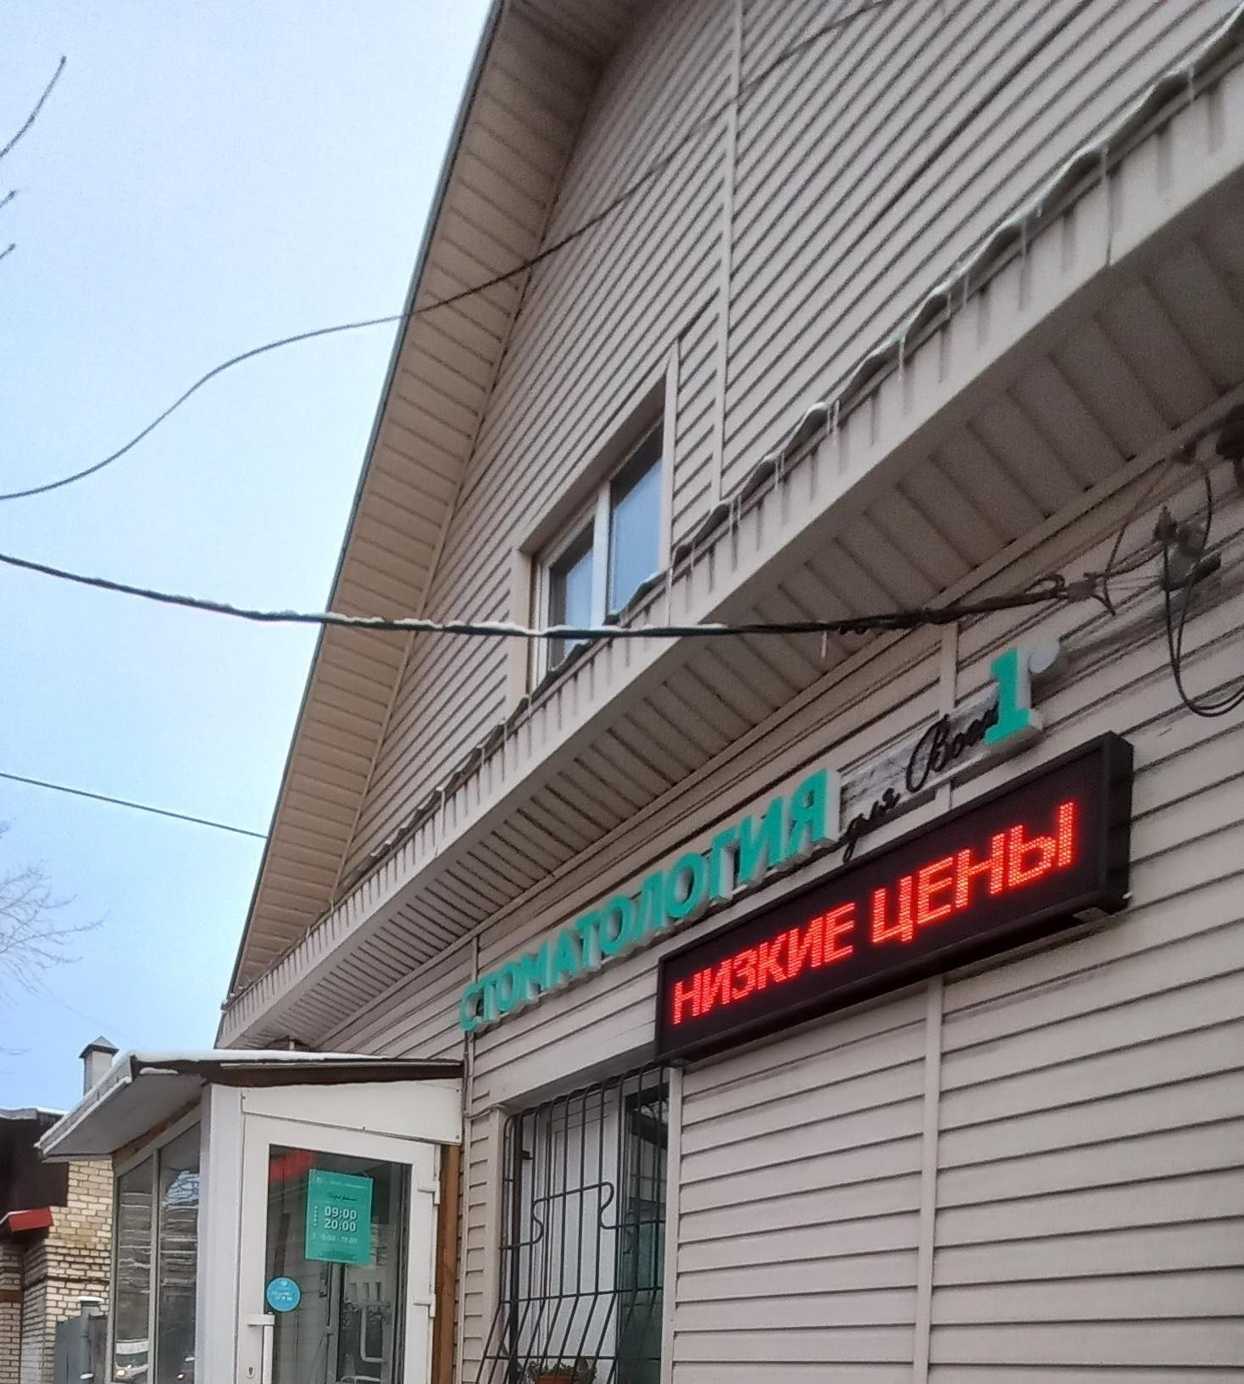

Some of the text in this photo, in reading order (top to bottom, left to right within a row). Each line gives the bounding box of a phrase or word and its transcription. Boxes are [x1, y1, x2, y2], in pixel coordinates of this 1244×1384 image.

[460, 768, 830, 1031] СТОМАТОЛОГИЯ
[672, 801, 1074, 1025] НИЗКИЕ ЦЕНЫ
[323, 1218, 356, 1232] 20:00
[324, 1206, 357, 1220] 09:00
